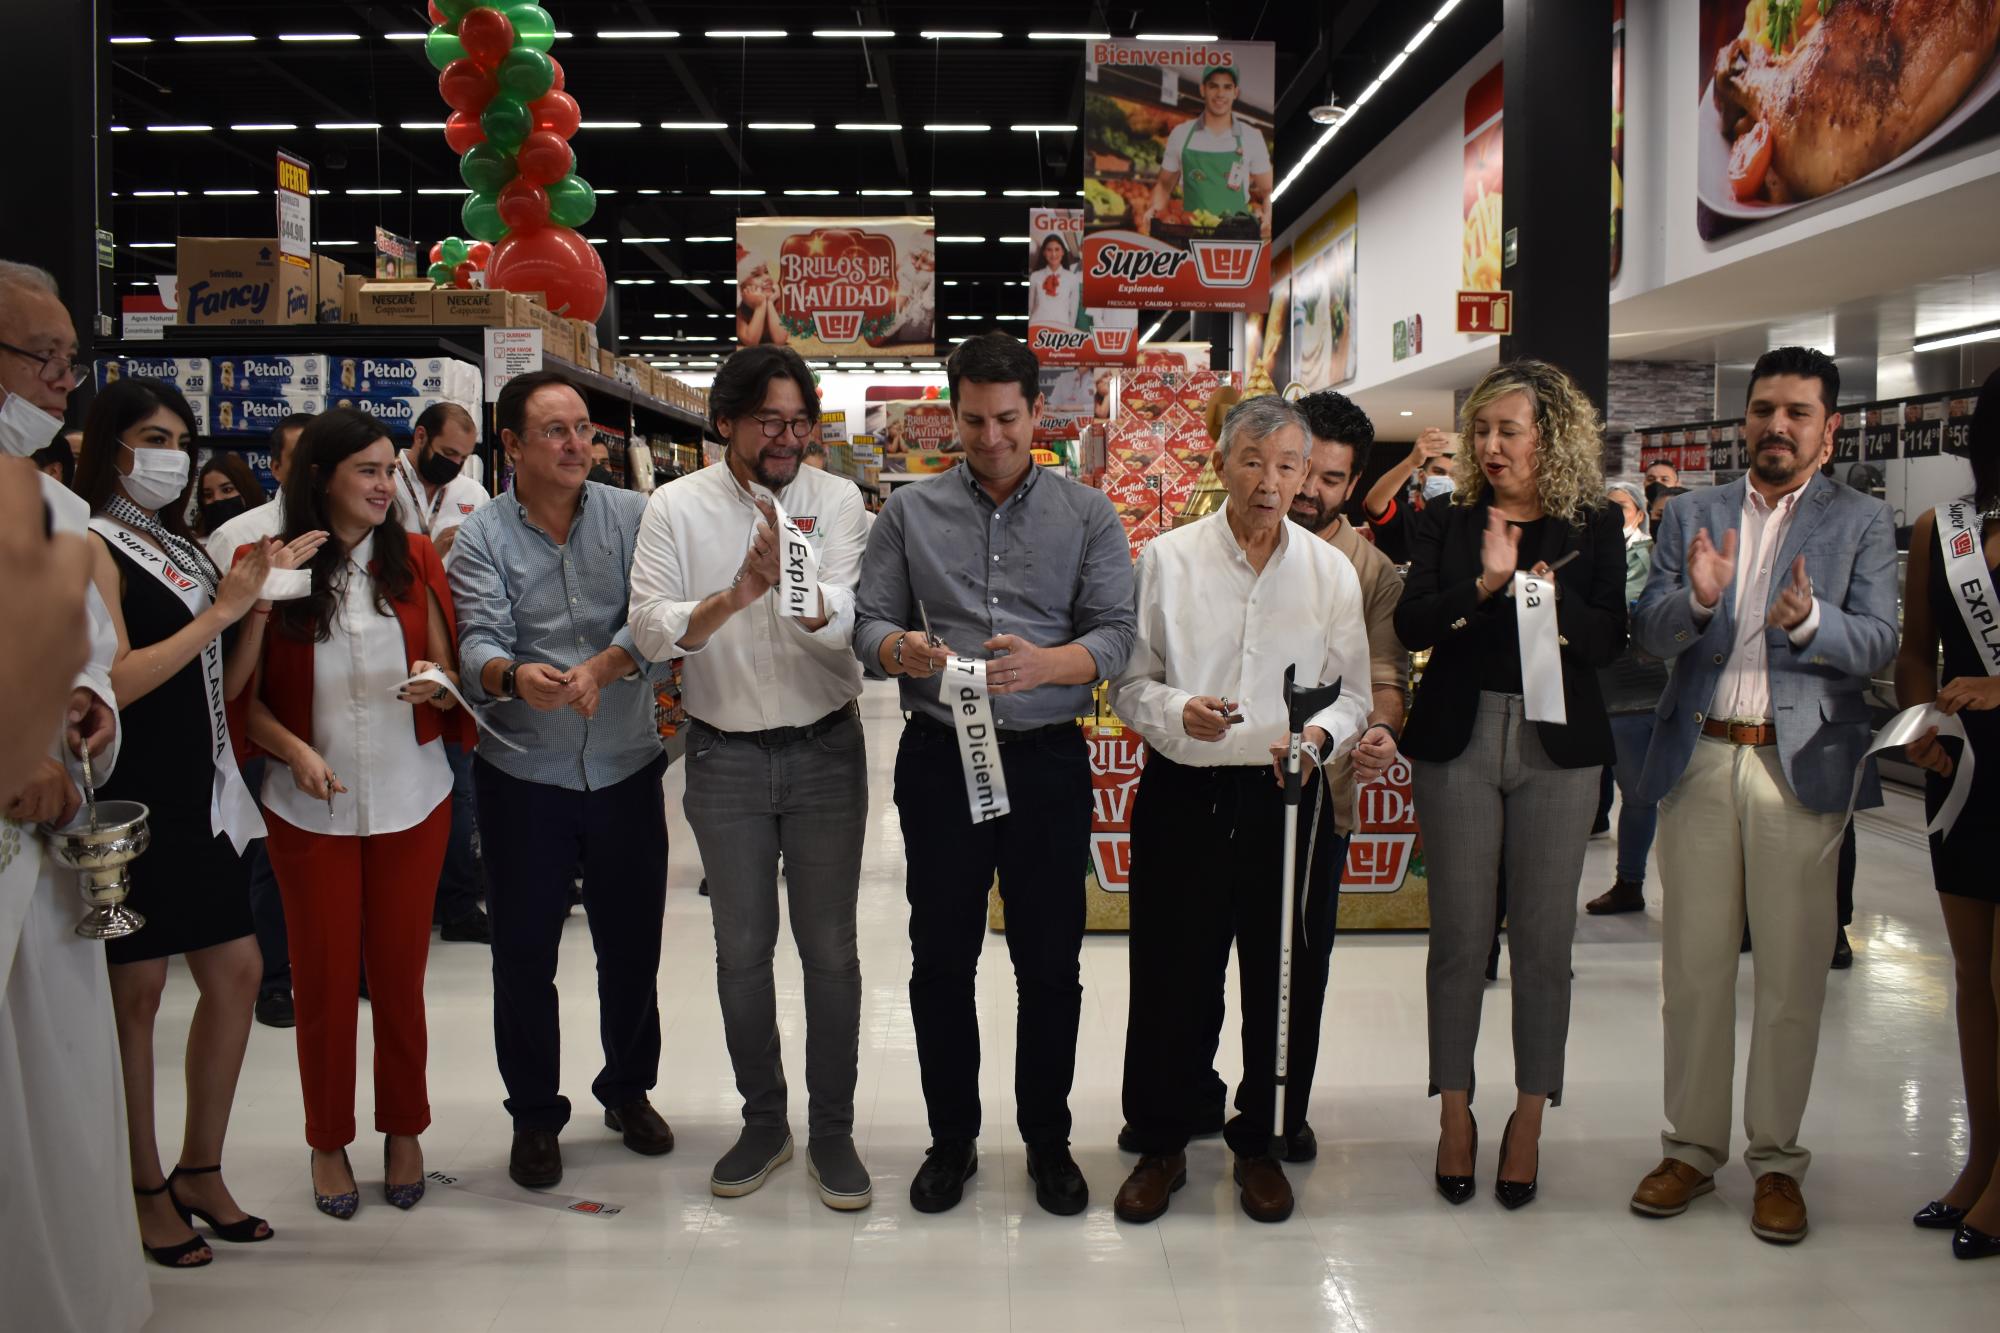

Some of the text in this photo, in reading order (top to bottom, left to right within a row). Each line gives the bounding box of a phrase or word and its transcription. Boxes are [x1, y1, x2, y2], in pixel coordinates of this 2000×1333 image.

[1093, 44, 1233, 66] Bienvenidos
[279, 160, 309, 195] OFERTA
[780, 254, 890, 284] BRILLOS DE
[1092, 245, 1188, 281] Super
[209, 269, 243, 279] Servilleta
[782, 279, 890, 312] NAVIDAD
[1118, 283, 1165, 294] Explanada
[186, 280, 270, 325] Fancy
[287, 286, 309, 320] Fancy
[372, 291, 416, 305] NESCAFÉ
[447, 293, 491, 306] NESCAFÉ
[131, 315, 149, 323] Agua
[1033, 329, 1089, 350] Super
[127, 359, 179, 378] Pétalo
[243, 360, 294, 378] Pétalo
[361, 359, 416, 379] Pétalo
[185, 377, 204, 387] 420
[300, 377, 319, 386] 420
[422, 379, 441, 388] 420
[1130, 379, 1161, 393] Surtido
[1185, 379, 1217, 393] Surtido
[1142, 389, 1160, 399] Rico
[241, 400, 293, 418] Pétalo
[358, 399, 412, 418] Pétalo
[906, 426, 950, 439] NAVIDAD
[1118, 428, 1150, 442] Surtido
[1174, 428, 1208, 442] Surtido
[1130, 438, 1150, 449] Rico
[1187, 438, 1206, 449] Rico
[1112, 482, 1145, 496] Surtido
[1124, 492, 1144, 503] Rico
[1949, 502, 1966, 529] Super
[113, 530, 162, 564] Super
[959, 686, 981, 716] de
